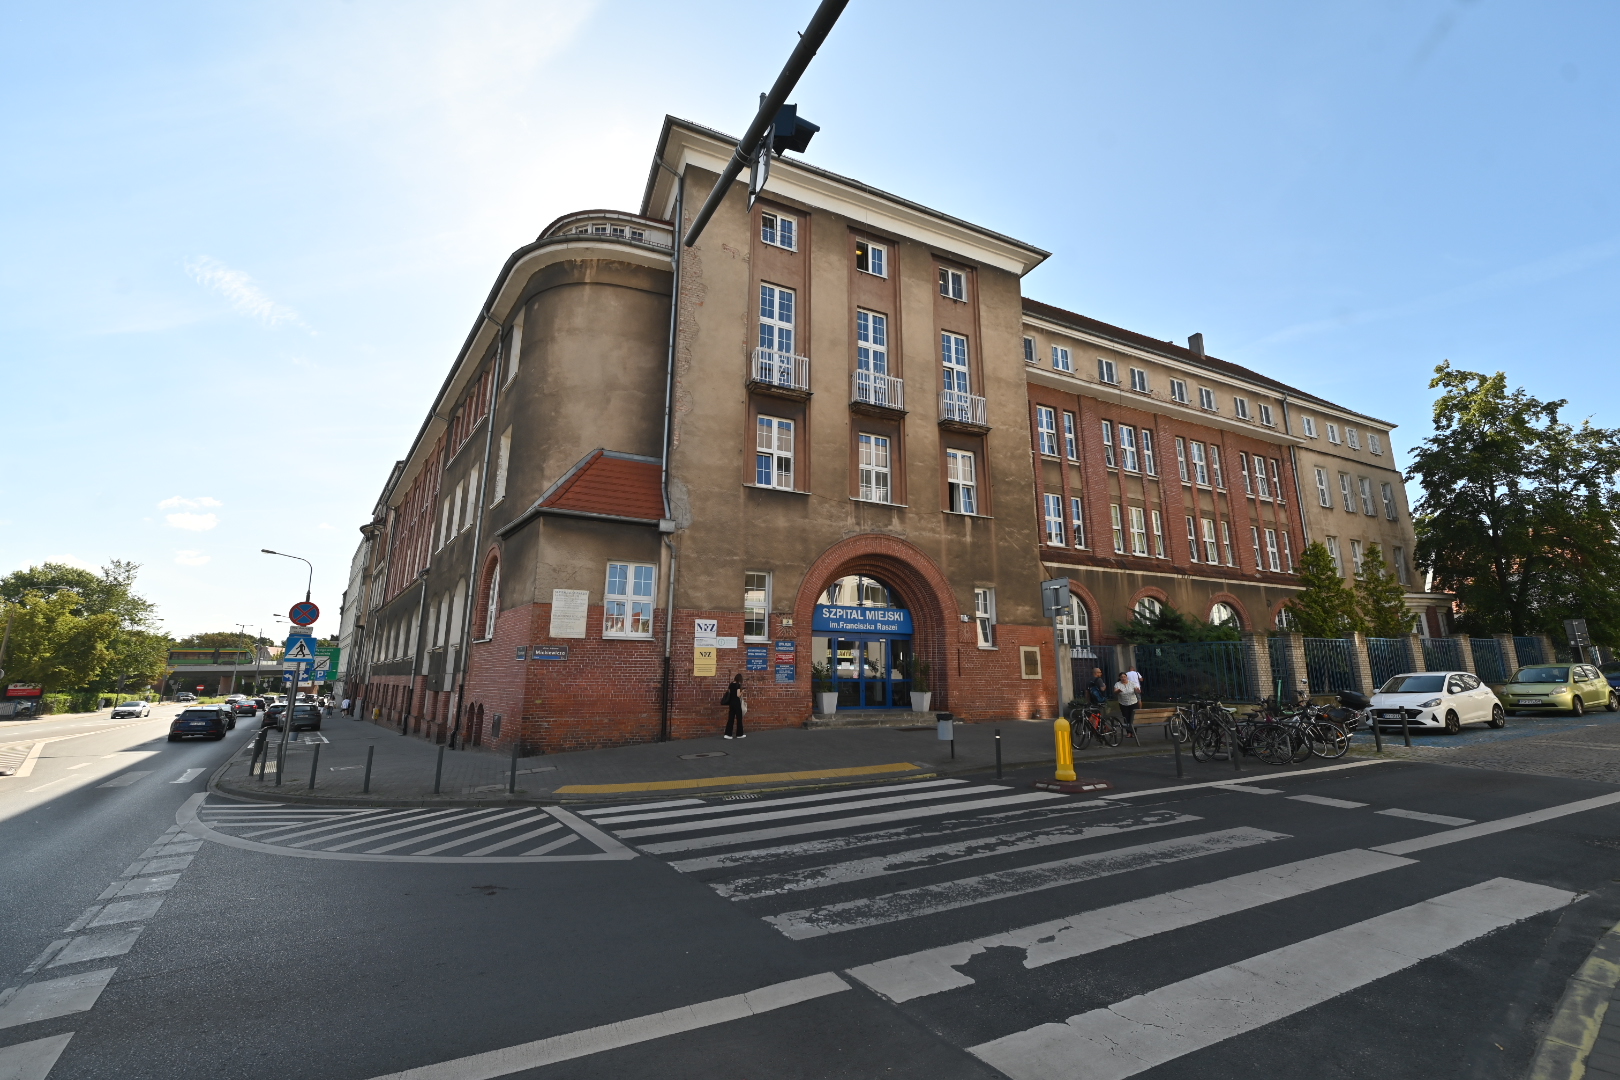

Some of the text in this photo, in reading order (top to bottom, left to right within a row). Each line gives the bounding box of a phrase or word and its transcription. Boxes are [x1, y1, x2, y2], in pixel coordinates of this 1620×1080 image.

[823, 608, 904, 621] SZPITAL MIEJSKI
[697, 623, 716, 632] NFZ
